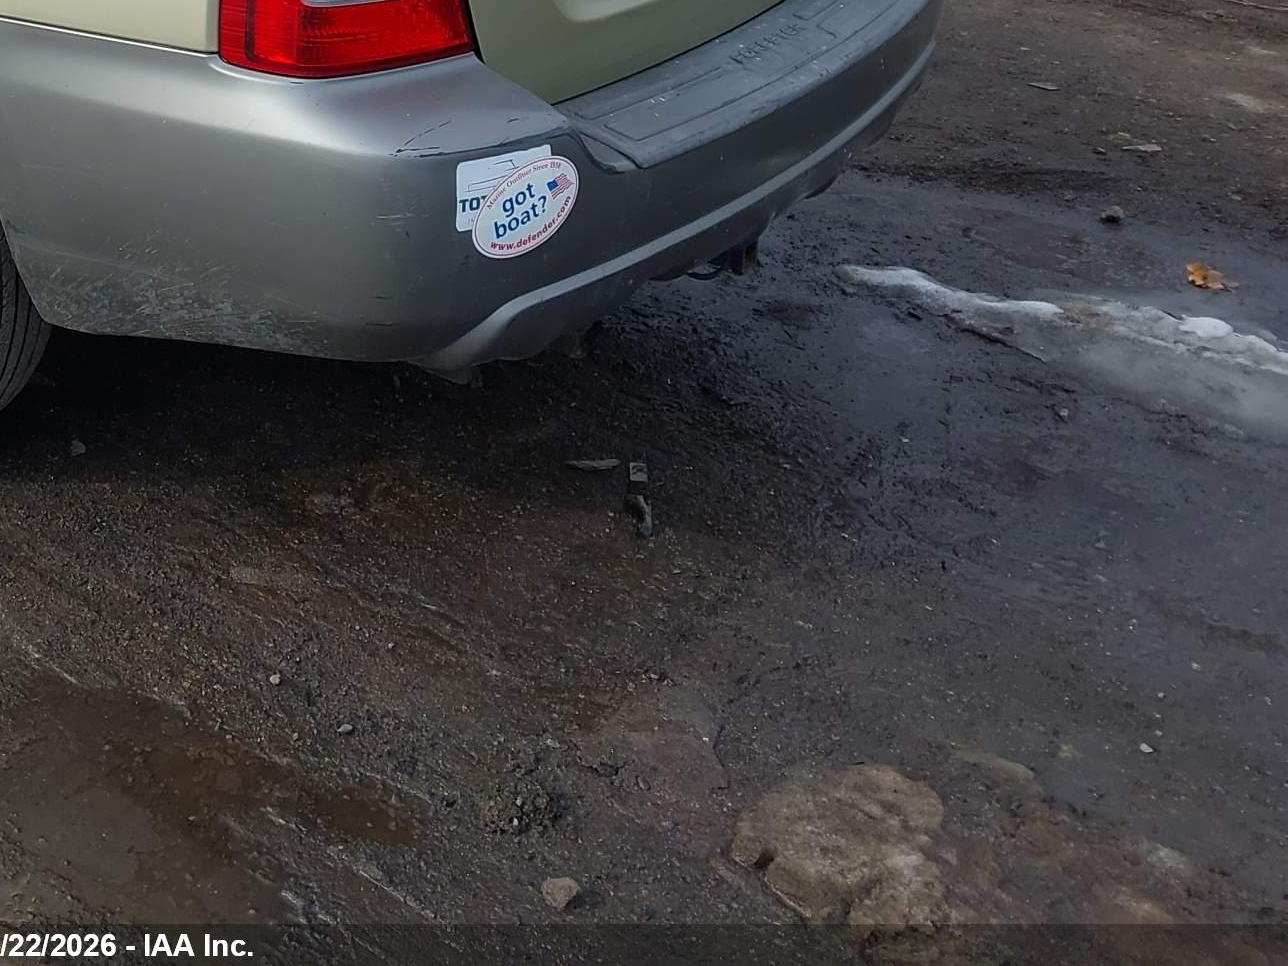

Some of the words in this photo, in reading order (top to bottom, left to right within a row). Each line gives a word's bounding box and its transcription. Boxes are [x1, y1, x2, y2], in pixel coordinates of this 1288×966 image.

[493, 195, 547, 239] boat?
[502, 182, 536, 218] got
[490, 195, 572, 251] www.defender.com
